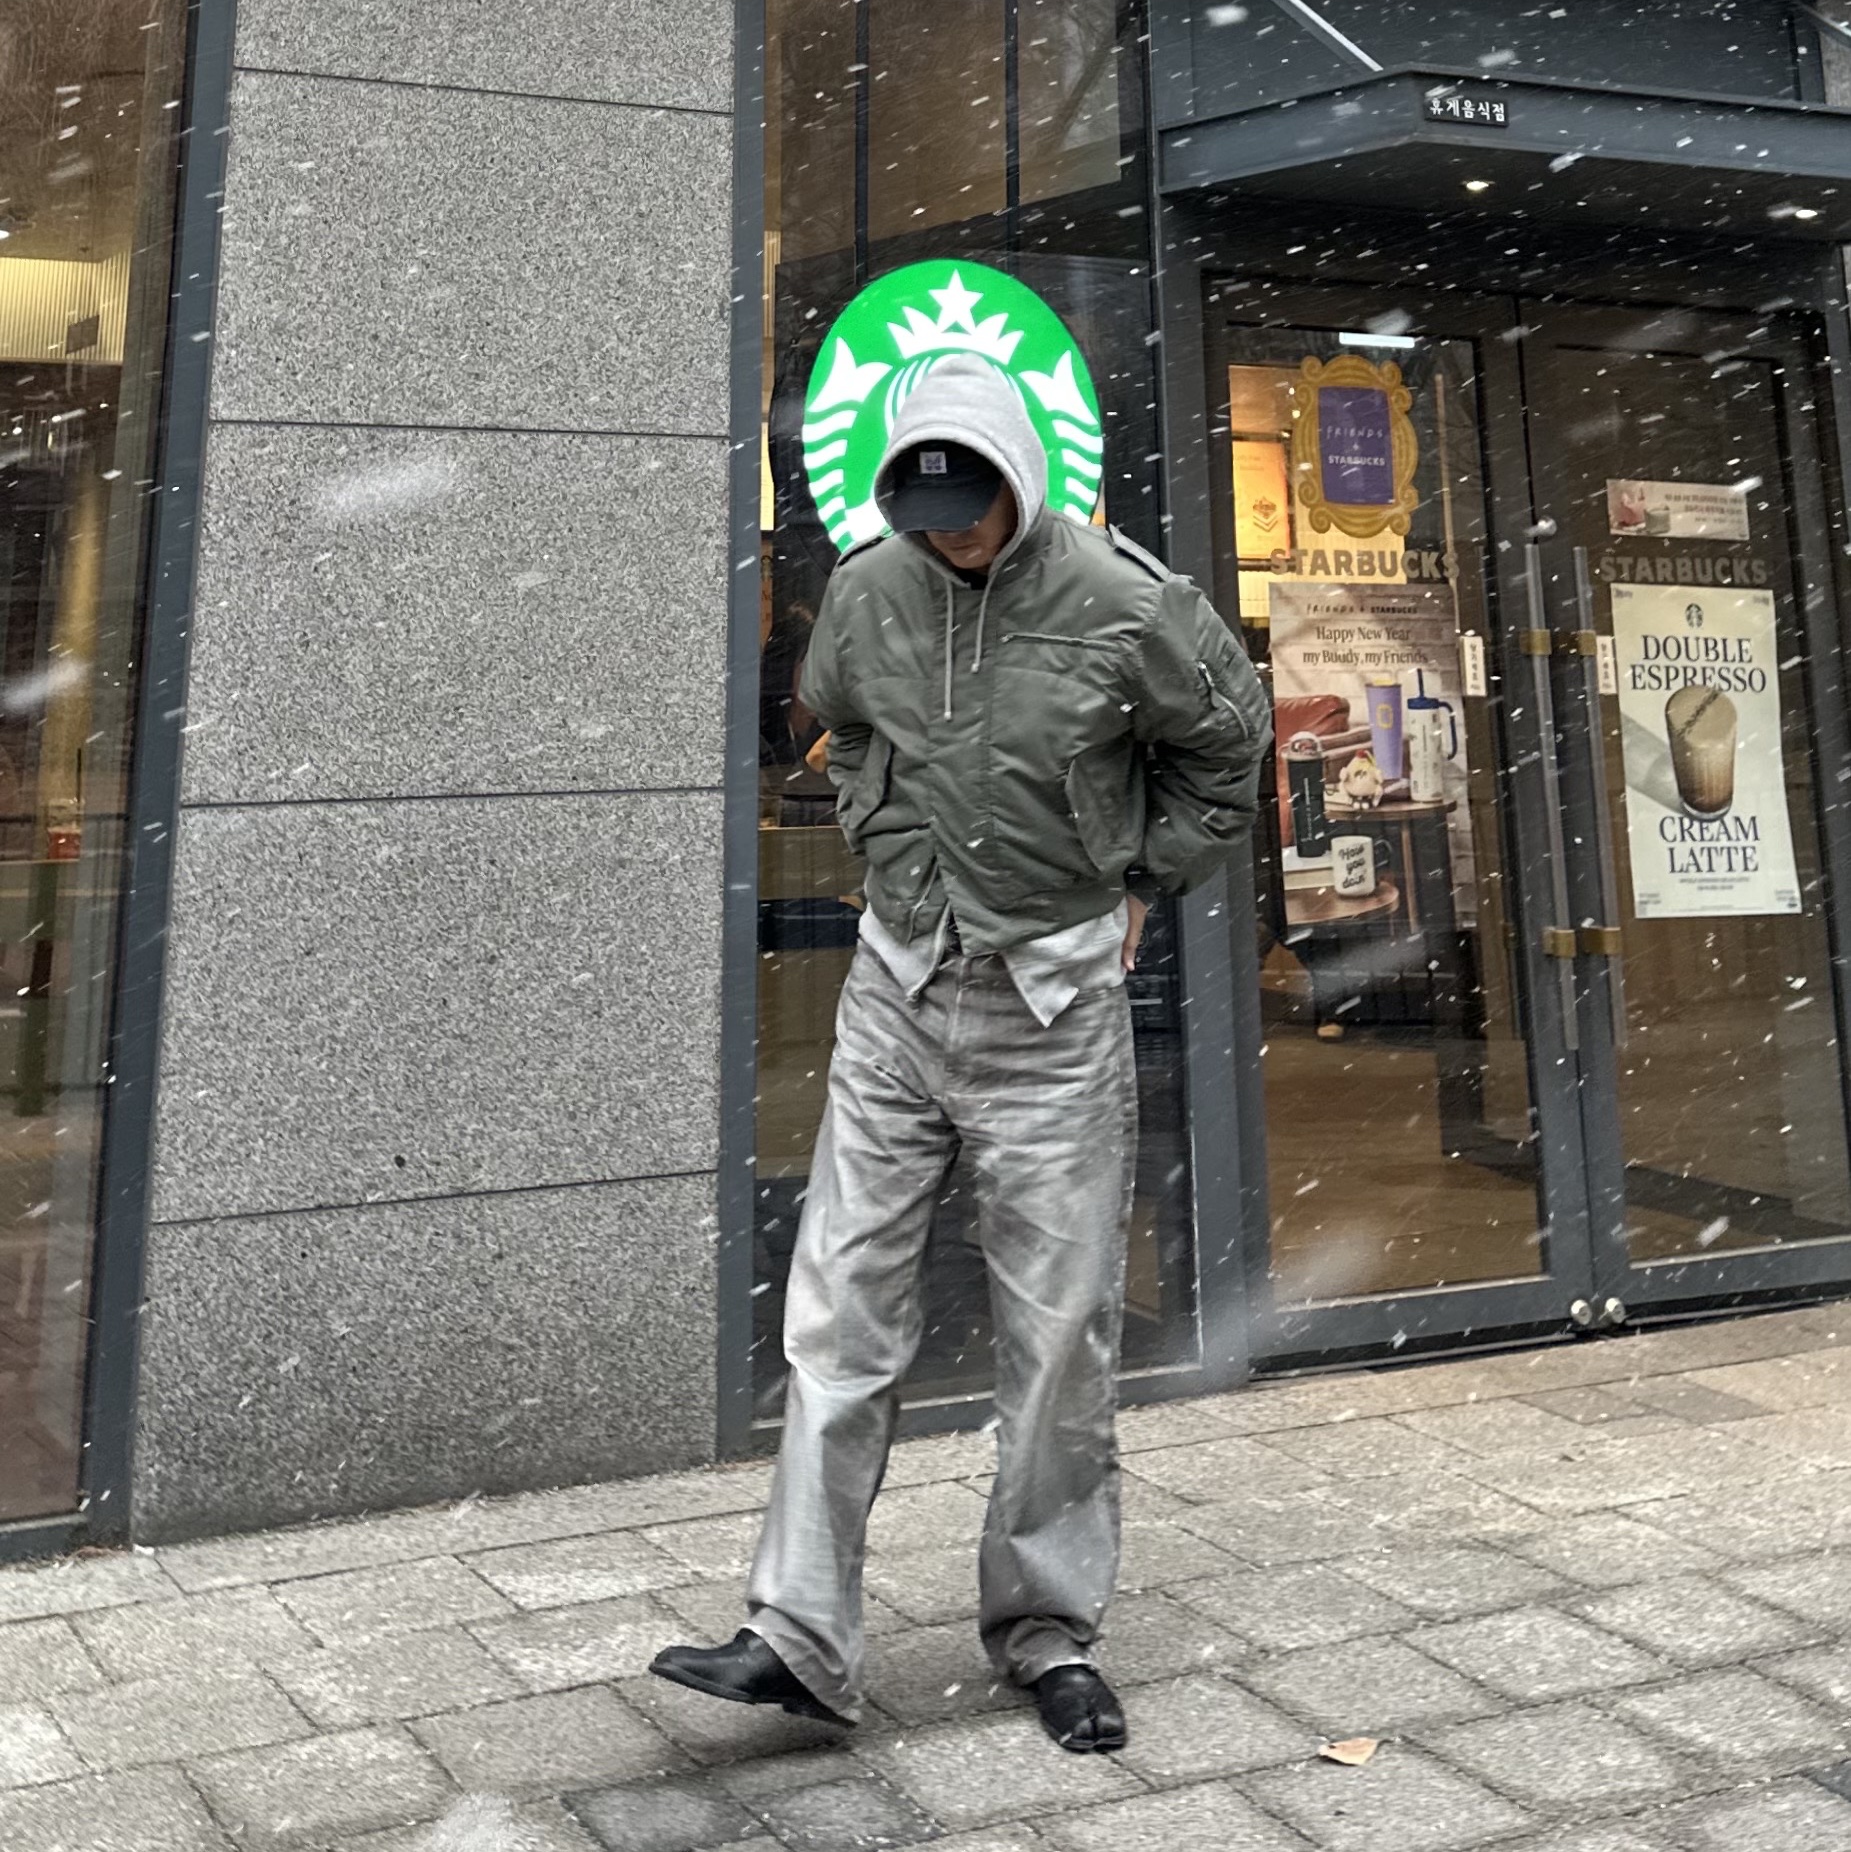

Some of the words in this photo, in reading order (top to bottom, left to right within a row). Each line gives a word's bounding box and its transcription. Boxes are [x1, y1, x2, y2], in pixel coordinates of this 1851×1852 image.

[1429, 98, 1505, 122] 휴게음식점
[1326, 426, 1384, 439] FRIENDS
[1328, 455, 1386, 467] STARBUCKS
[1270, 548, 1460, 580] STARBUCKS
[1600, 556, 1768, 585] STARBUCKS
[1370, 606, 1418, 614] STARBUCKS
[1316, 626, 1356, 643] Happy
[1357, 626, 1382, 641] New
[1384, 627, 1411, 641] Year
[1302, 652, 1320, 666] my
[1365, 652, 1383, 666] my
[1641, 635, 1753, 664] DOUBLE
[1630, 664, 1766, 693] ESPRESSO
[1659, 815, 1760, 843] CREAM
[1338, 844, 1365, 860] How
[1668, 845, 1759, 874] LATTE
[1346, 858, 1366, 875] you
